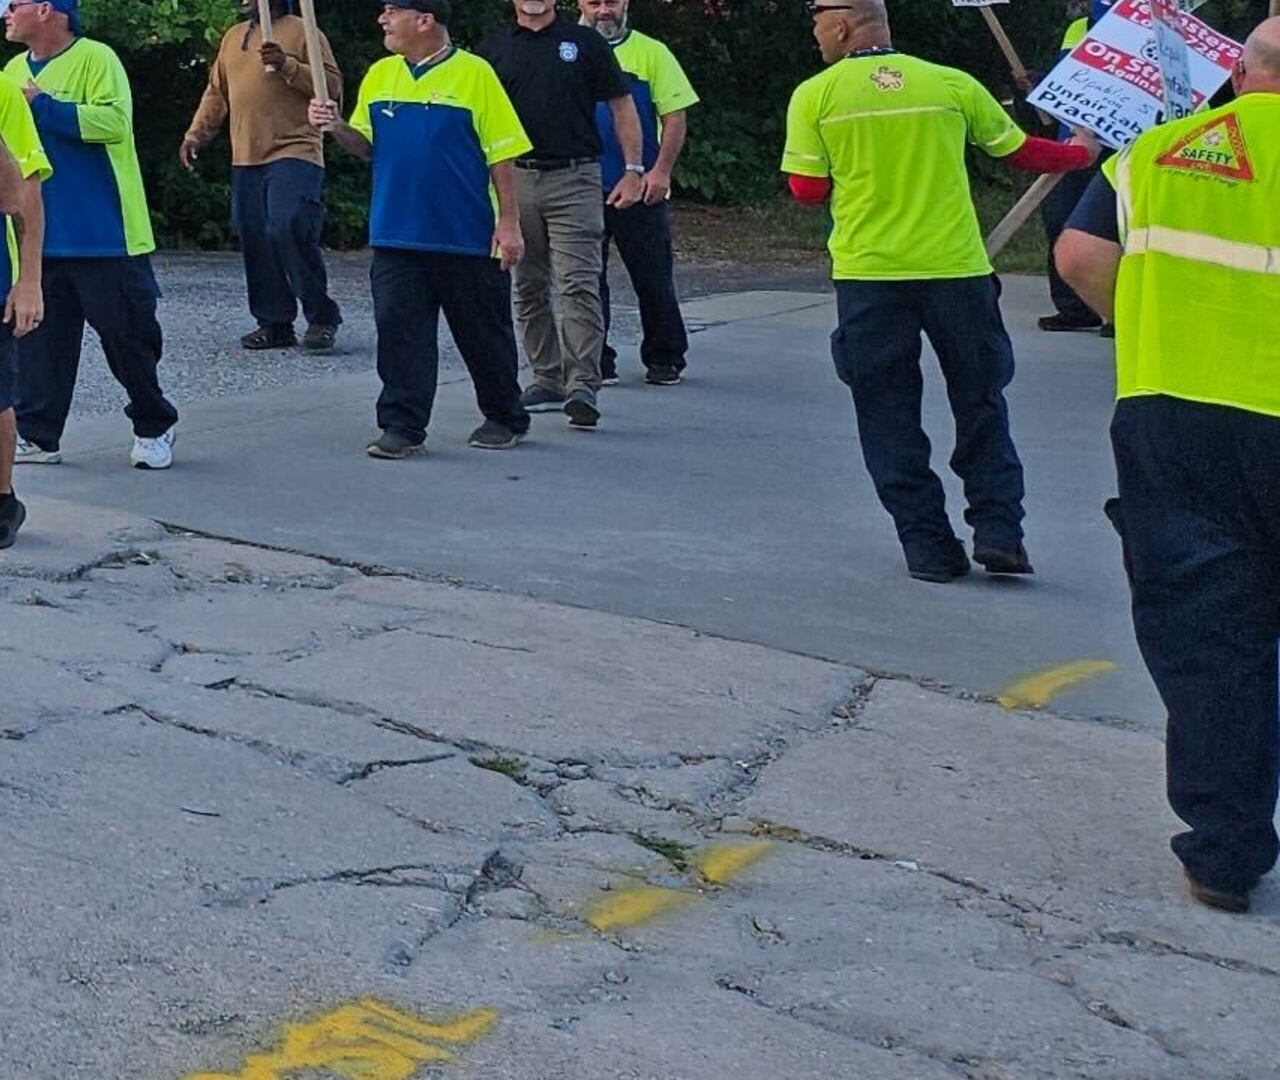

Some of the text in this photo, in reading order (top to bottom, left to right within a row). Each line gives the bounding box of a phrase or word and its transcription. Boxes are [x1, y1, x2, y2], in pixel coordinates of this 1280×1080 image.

[1085, 42, 1121, 64] On
[1185, 37, 1220, 61] 728
[1103, 65, 1163, 98] Against
[1037, 91, 1132, 144] Practic
[1047, 81, 1142, 134] Unfair Lab
[1181, 148, 1233, 165] SAFETY
